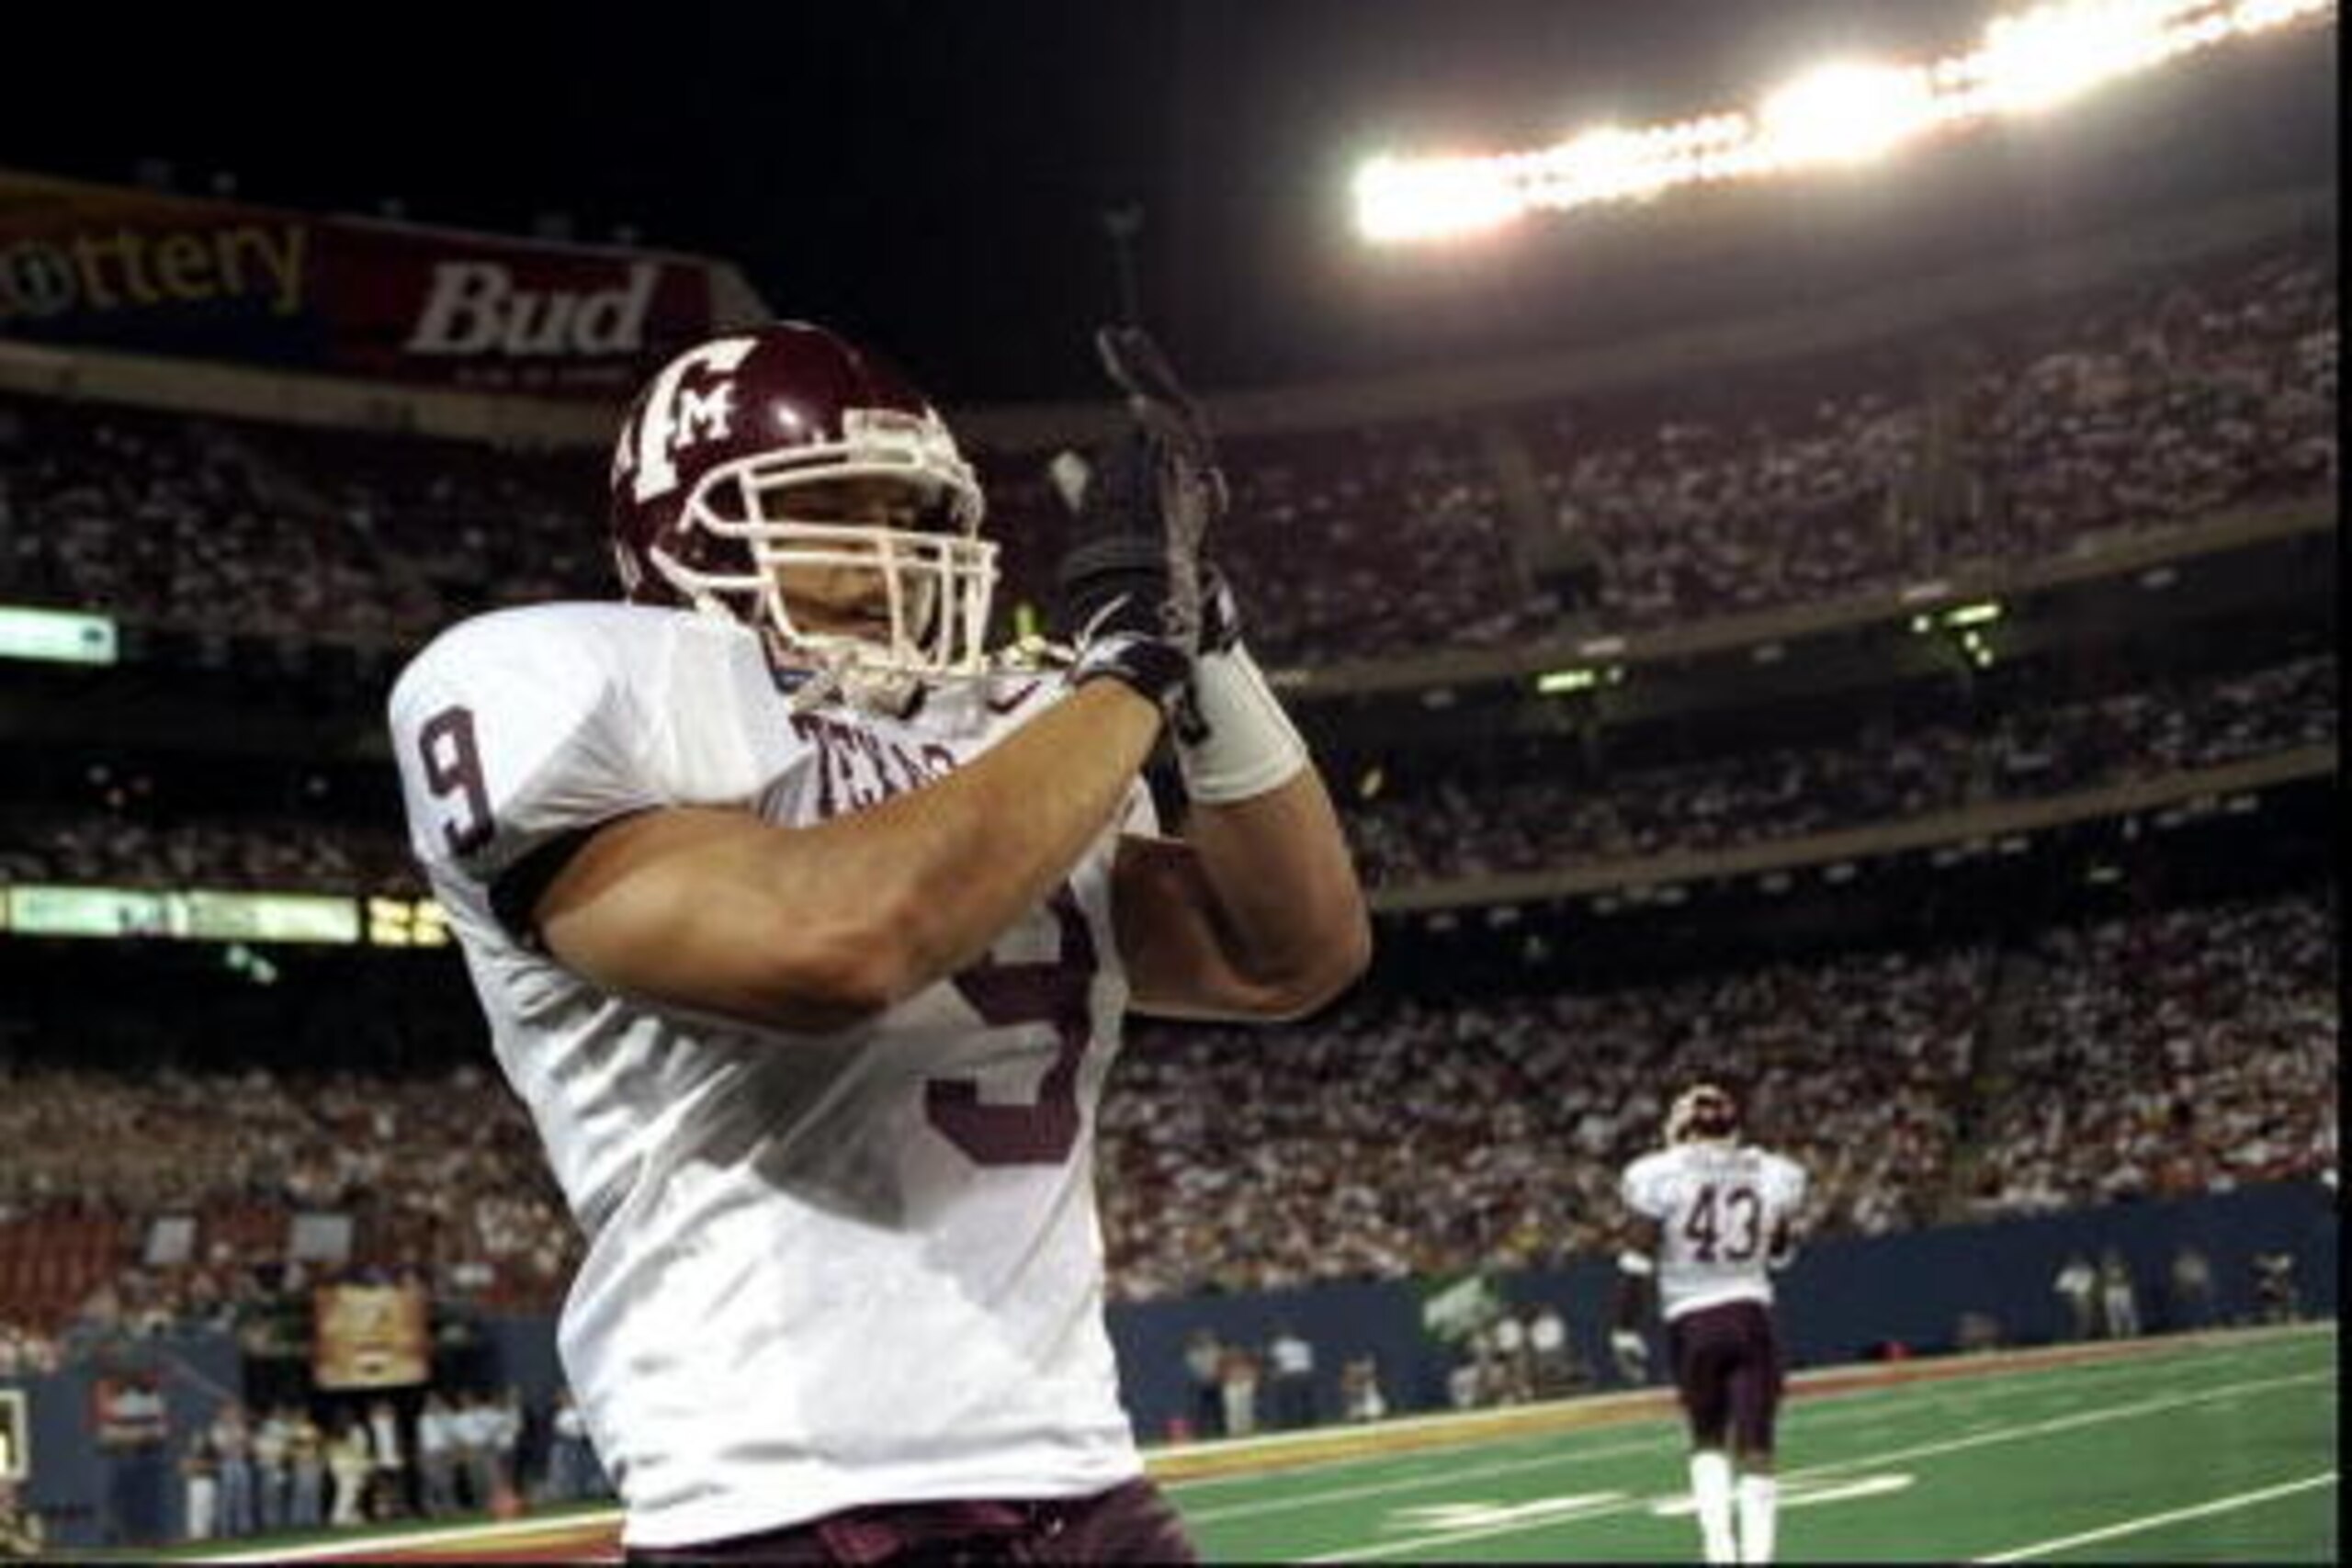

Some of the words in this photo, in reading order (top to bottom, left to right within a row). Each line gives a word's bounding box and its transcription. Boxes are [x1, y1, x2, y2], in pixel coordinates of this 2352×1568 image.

[405, 261, 657, 356] Bud
[420, 705, 496, 856] 9
[1685, 1184, 1761, 1262] 43
